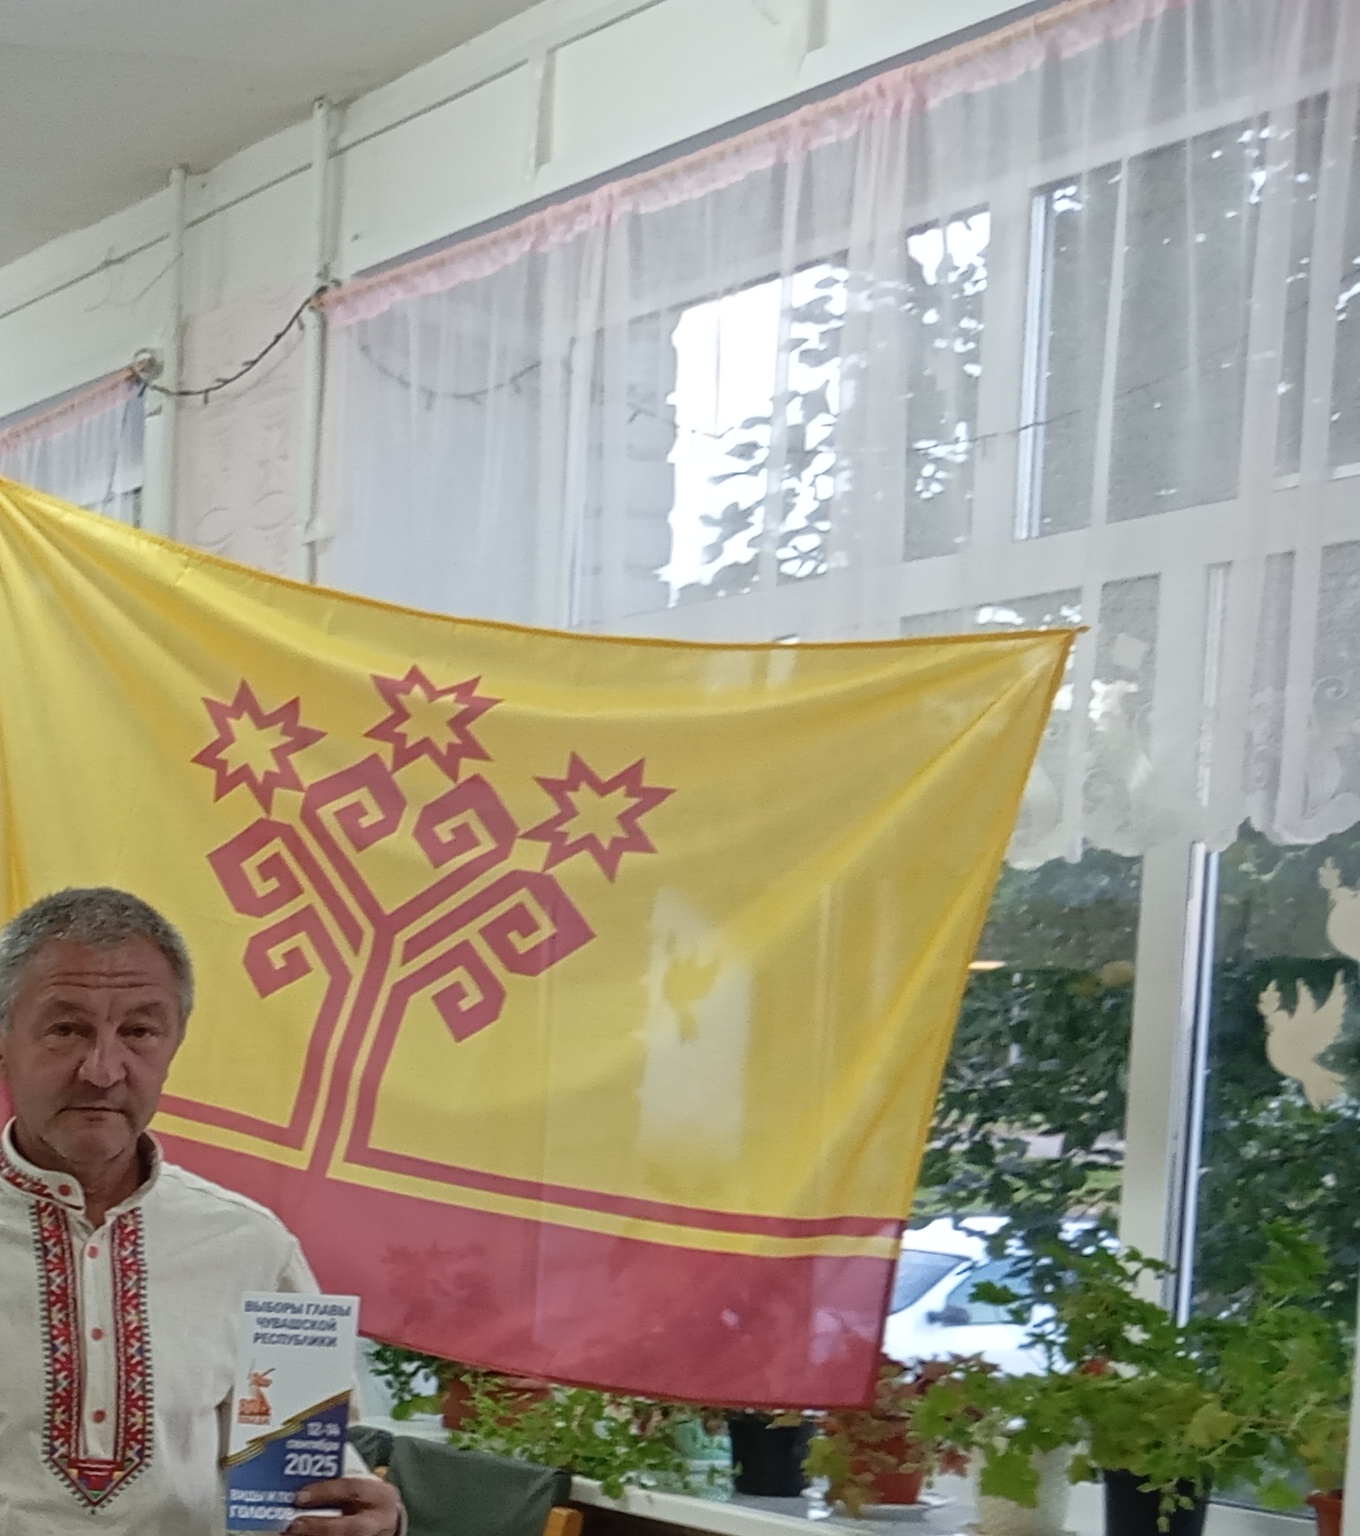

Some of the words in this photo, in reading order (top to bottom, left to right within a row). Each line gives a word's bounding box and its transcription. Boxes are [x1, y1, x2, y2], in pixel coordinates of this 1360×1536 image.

[244, 1300, 303, 1315] ВЫБОРЫ
[305, 1302, 352, 1317] ГЛАВЫ
[255, 1316, 337, 1332] ЧУВАШСКОЙ
[252, 1331, 338, 1348] РЕСПУБЛИКИ
[283, 1452, 339, 1477] 2025
